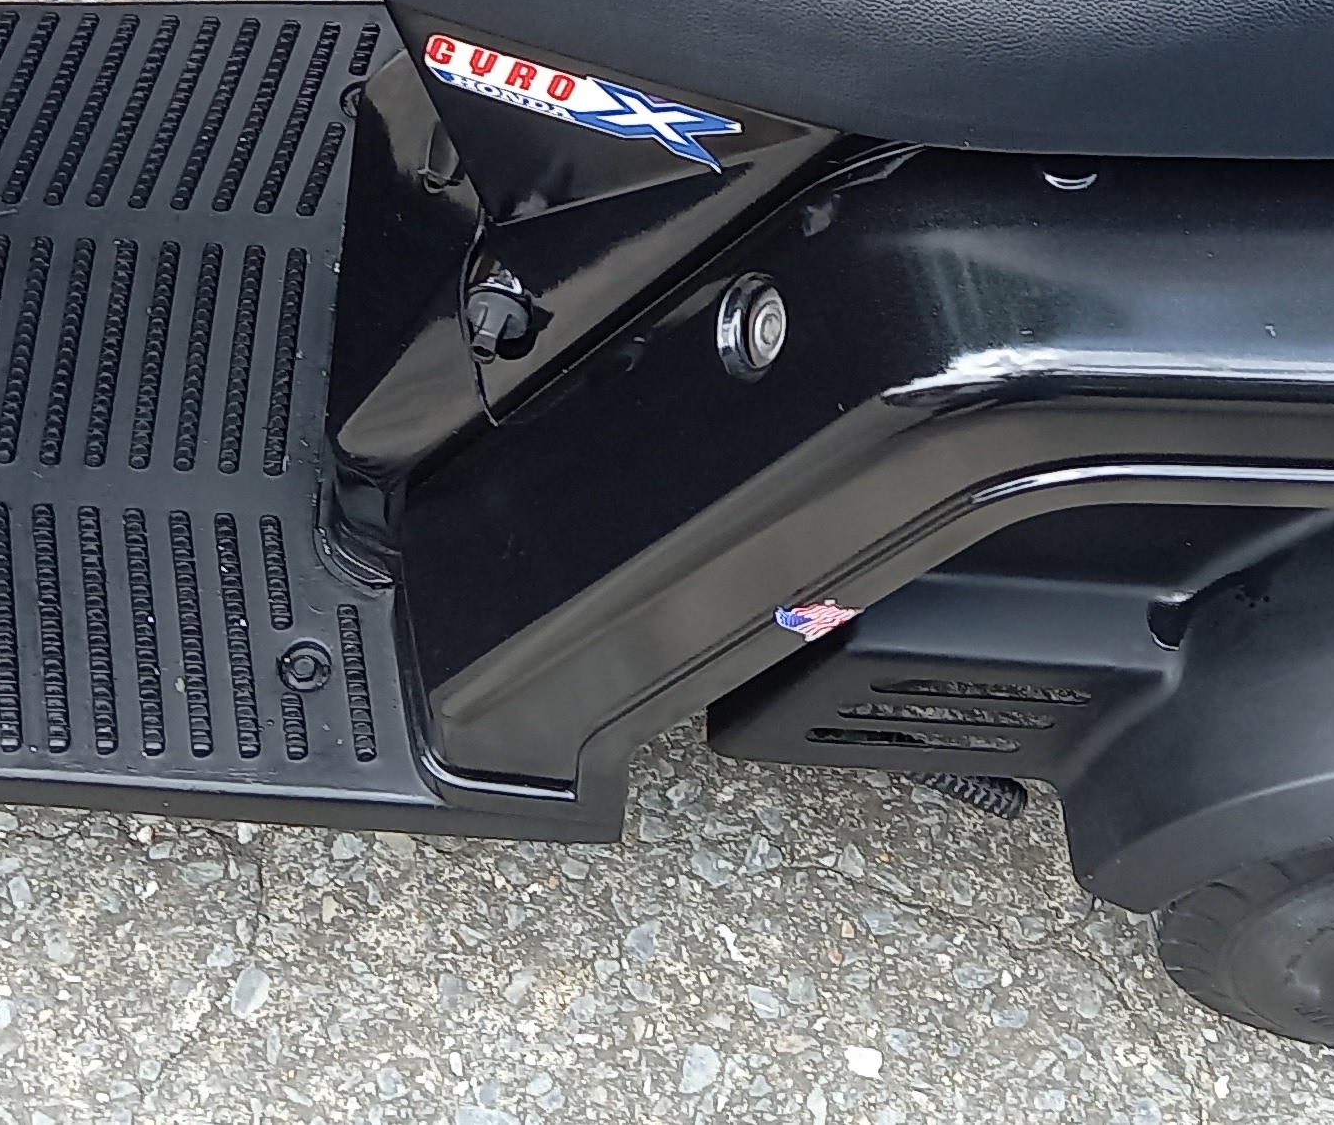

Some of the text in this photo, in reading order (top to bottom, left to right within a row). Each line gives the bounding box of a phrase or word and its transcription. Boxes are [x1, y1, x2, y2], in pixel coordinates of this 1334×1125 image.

[428, 37, 723, 160] GYRO X
[449, 73, 572, 119] HONDA
